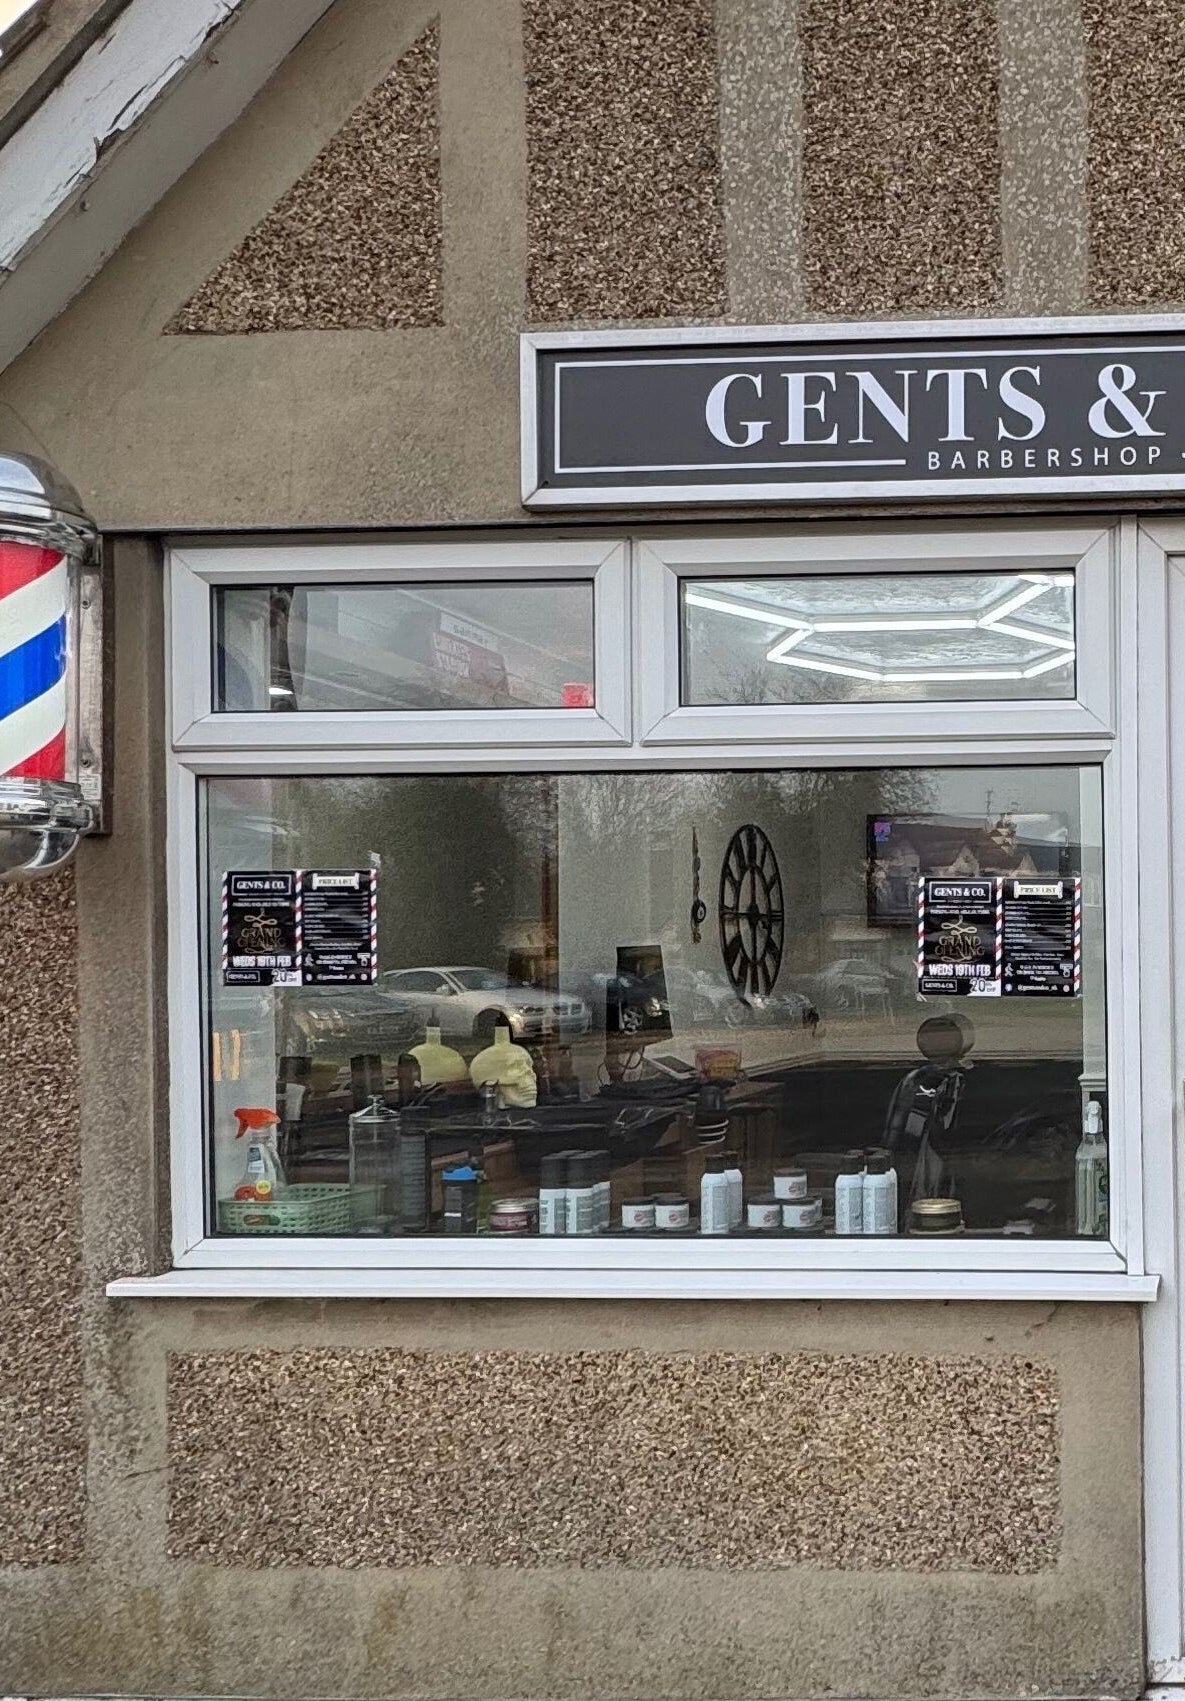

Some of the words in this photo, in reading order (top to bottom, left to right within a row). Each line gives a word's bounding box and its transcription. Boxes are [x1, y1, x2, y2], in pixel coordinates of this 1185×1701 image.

[705, 365, 1046, 448] GENTS
[1088, 363, 1168, 439] &
[928, 445, 1162, 470] BARBERSHOP
[236, 880, 263, 889] GENTS
[264, 880, 270, 889] &
[934, 887, 962, 897] GENTS
[963, 887, 970, 896] &
[241, 927, 282, 938] GRAND
[939, 936, 981, 946] GRAND
[934, 945, 985, 956] OPENING
[928, 963, 954, 976] WEDS
[954, 964, 975, 976] 19TH
[970, 978, 986, 992] 20
